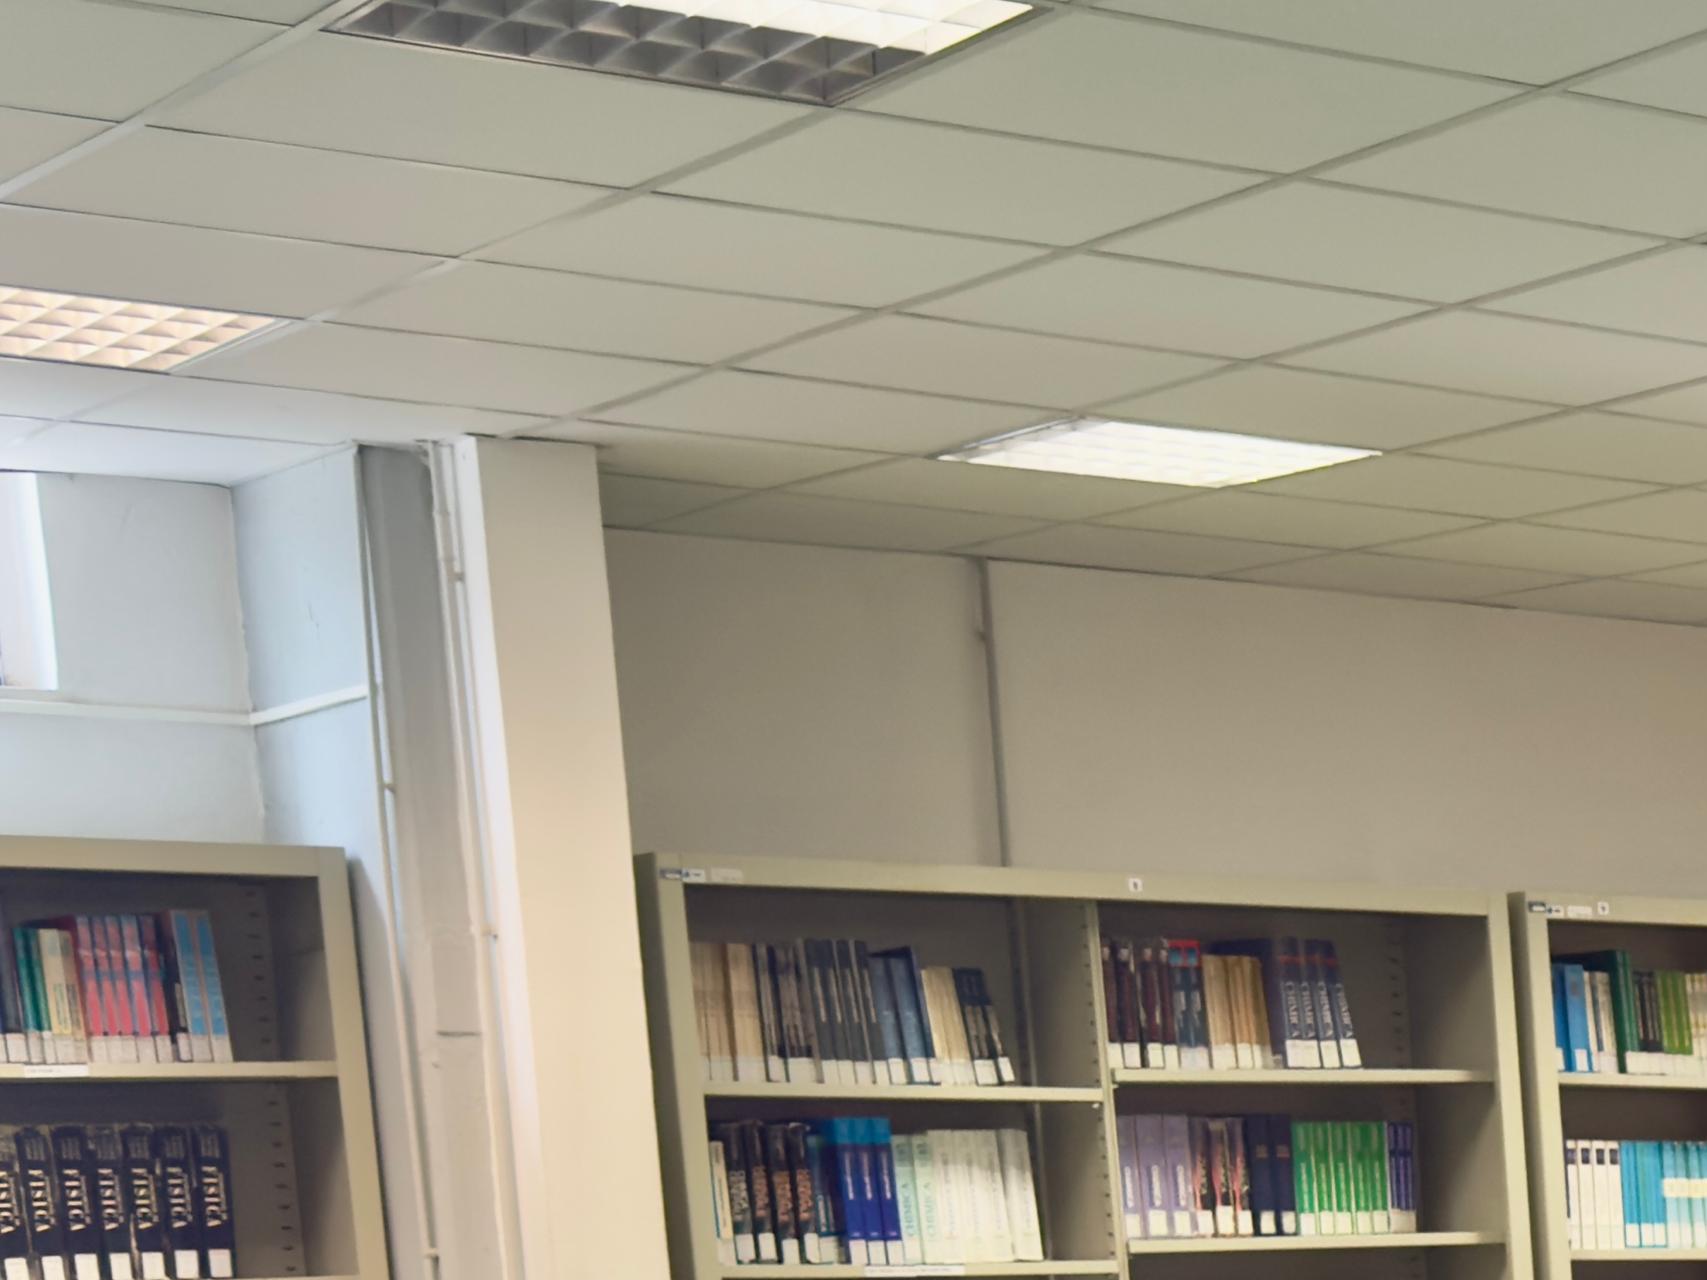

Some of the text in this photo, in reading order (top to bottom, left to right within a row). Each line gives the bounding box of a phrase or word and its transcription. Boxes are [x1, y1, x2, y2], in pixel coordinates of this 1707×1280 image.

[28, 1170, 51, 1232] FISICA
[62, 1169, 86, 1231] FISICA
[97, 1168, 119, 1230] FISICA
[131, 1167, 153, 1230] FISICA
[166, 1166, 188, 1229] FISICA
[201, 1165, 223, 1228] FISICA
